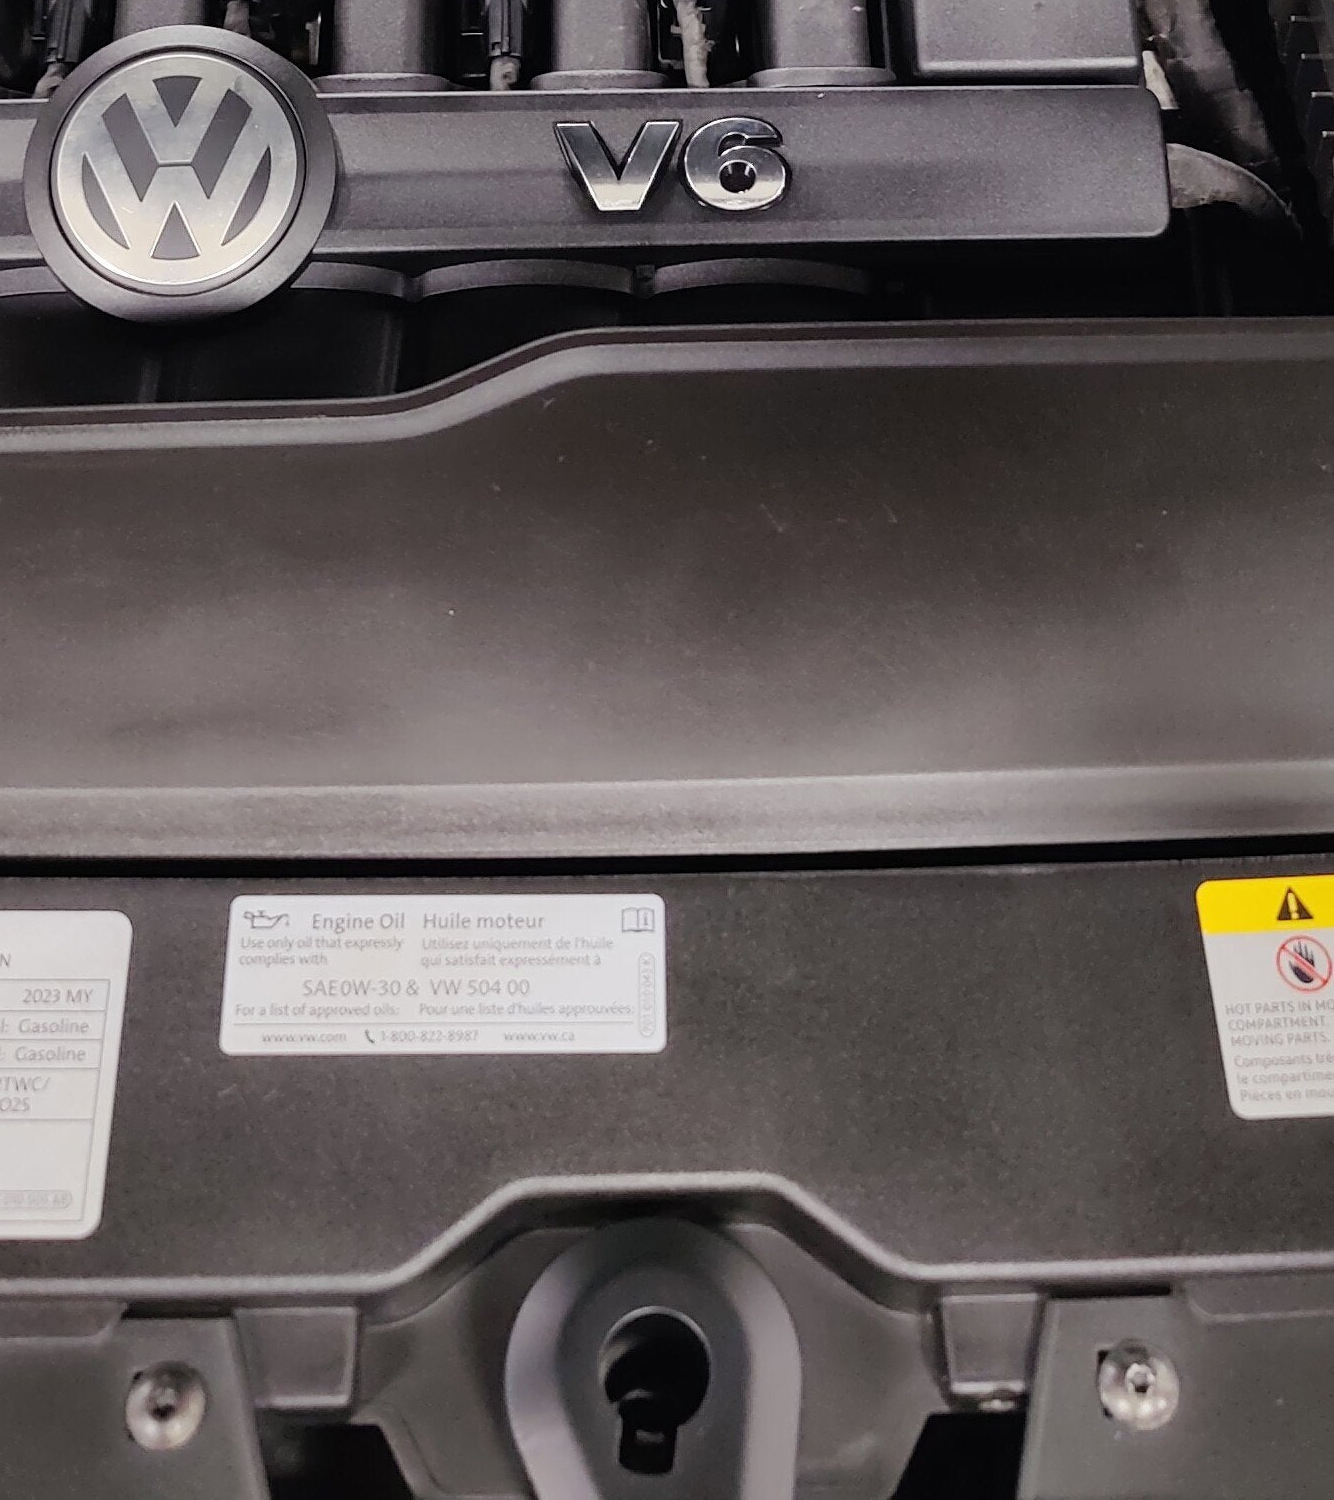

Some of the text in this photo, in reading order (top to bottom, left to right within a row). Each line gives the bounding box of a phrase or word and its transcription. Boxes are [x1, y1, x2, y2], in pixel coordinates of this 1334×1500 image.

[555, 115, 793, 214] V6
[312, 912, 405, 934] Engine Oil
[422, 912, 545, 930] Huile moteur
[240, 936, 405, 952] Use only oil that expressly
[422, 936, 614, 952] Utilisez uniquement de l'huile
[238, 953, 328, 968] complies with
[421, 953, 442, 968] qui
[445, 953, 497, 966] satisfait
[499, 953, 591, 968] expressément
[302, 979, 419, 997] SAE0W-30 &
[429, 978, 531, 996] VW 504 00
[22, 989, 94, 1004] 2023 MY
[235, 1003, 256, 1016] For
[270, 1002, 289, 1017] list
[292, 1002, 307, 1016] of
[309, 1002, 370, 1020] approved
[373, 1002, 400, 1016] oils:
[419, 1002, 448, 1016] Pour
[451, 1004, 475, 1016] une
[478, 1002, 504, 1016] liste
[507, 1001, 555, 1016] d'huiles
[1225, 1003, 1252, 1016] HOT
[1255, 1000, 1295, 1015] PARTS
[1298, 1000, 1312, 1012] IN
[19, 1018, 90, 1034] Gasoline
[1231, 1032, 1284, 1047] MOVING
[14, 1046, 86, 1062] Gasoline
[1233, 1053, 1313, 1069] Composants
[1285, 1088, 1302, 1100] en
